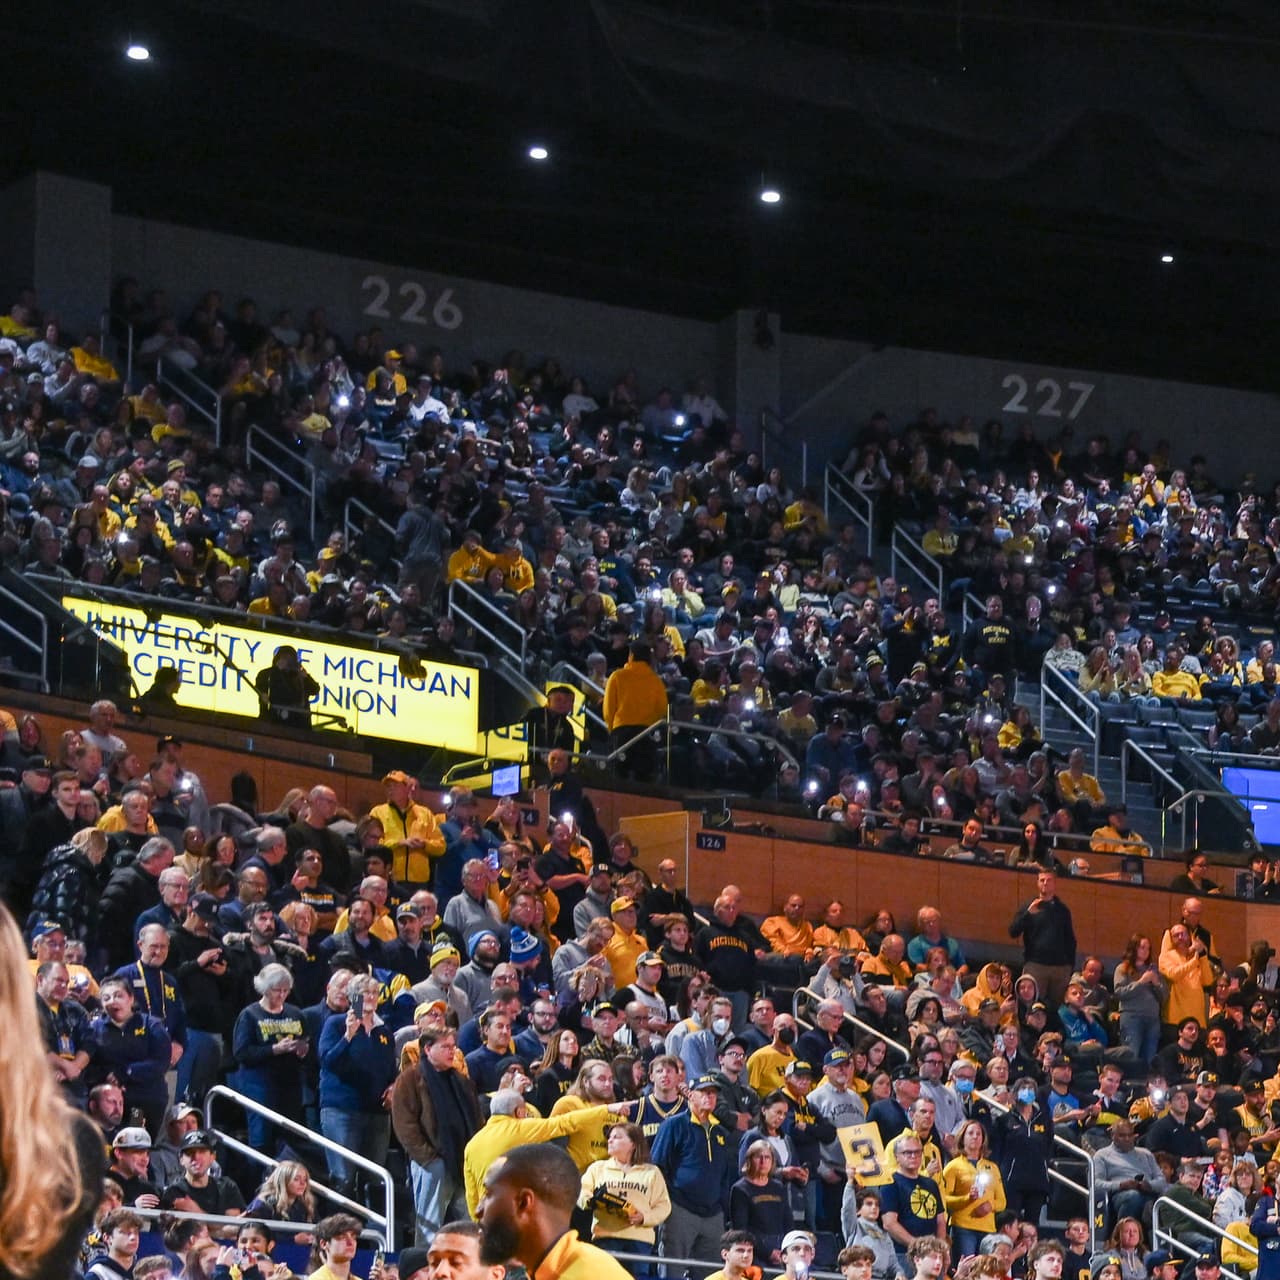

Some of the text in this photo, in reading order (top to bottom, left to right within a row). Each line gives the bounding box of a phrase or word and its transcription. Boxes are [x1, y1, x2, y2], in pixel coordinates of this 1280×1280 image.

[360, 274, 464, 331] 226
[1002, 373, 1095, 421] 227
[309, 684, 397, 718] NION
[701, 836, 721, 849] 126
[709, 935, 748, 952] MICHIGAN
[851, 1138, 882, 1177] 3
